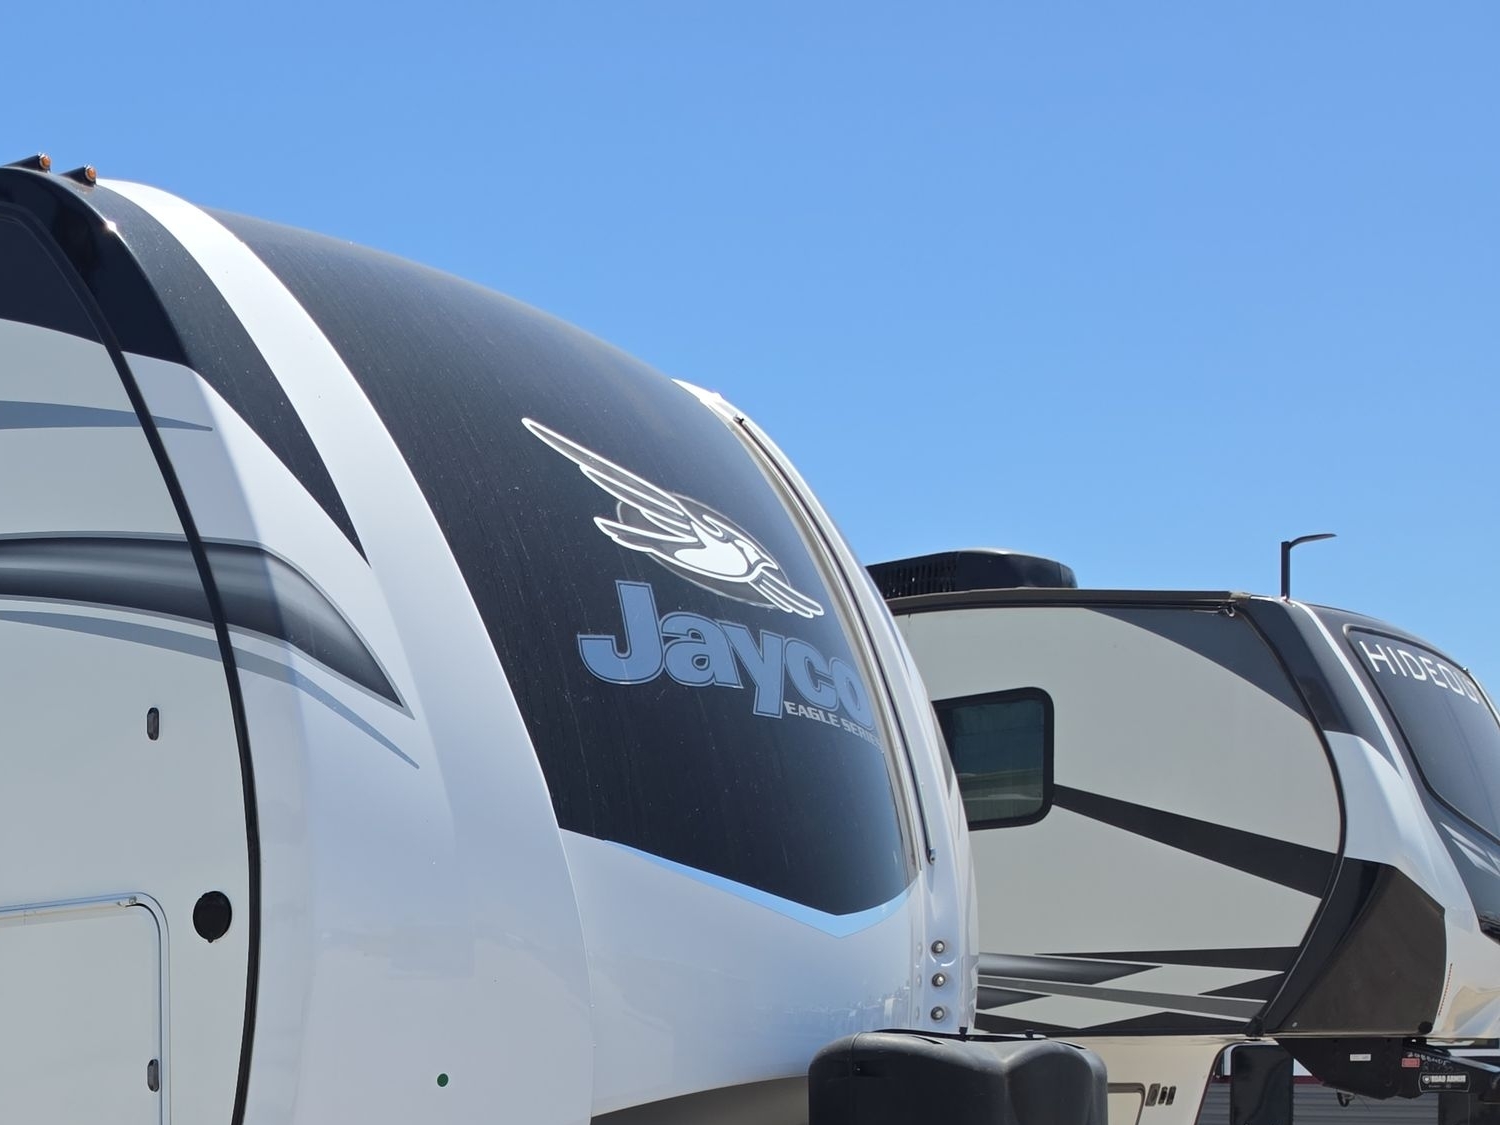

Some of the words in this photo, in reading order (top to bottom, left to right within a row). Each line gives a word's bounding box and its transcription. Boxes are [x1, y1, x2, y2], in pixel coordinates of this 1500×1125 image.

[577, 580, 874, 731] Jayco
[1359, 640, 1480, 705] HIDEOU
[783, 701, 841, 728] EAGLE
